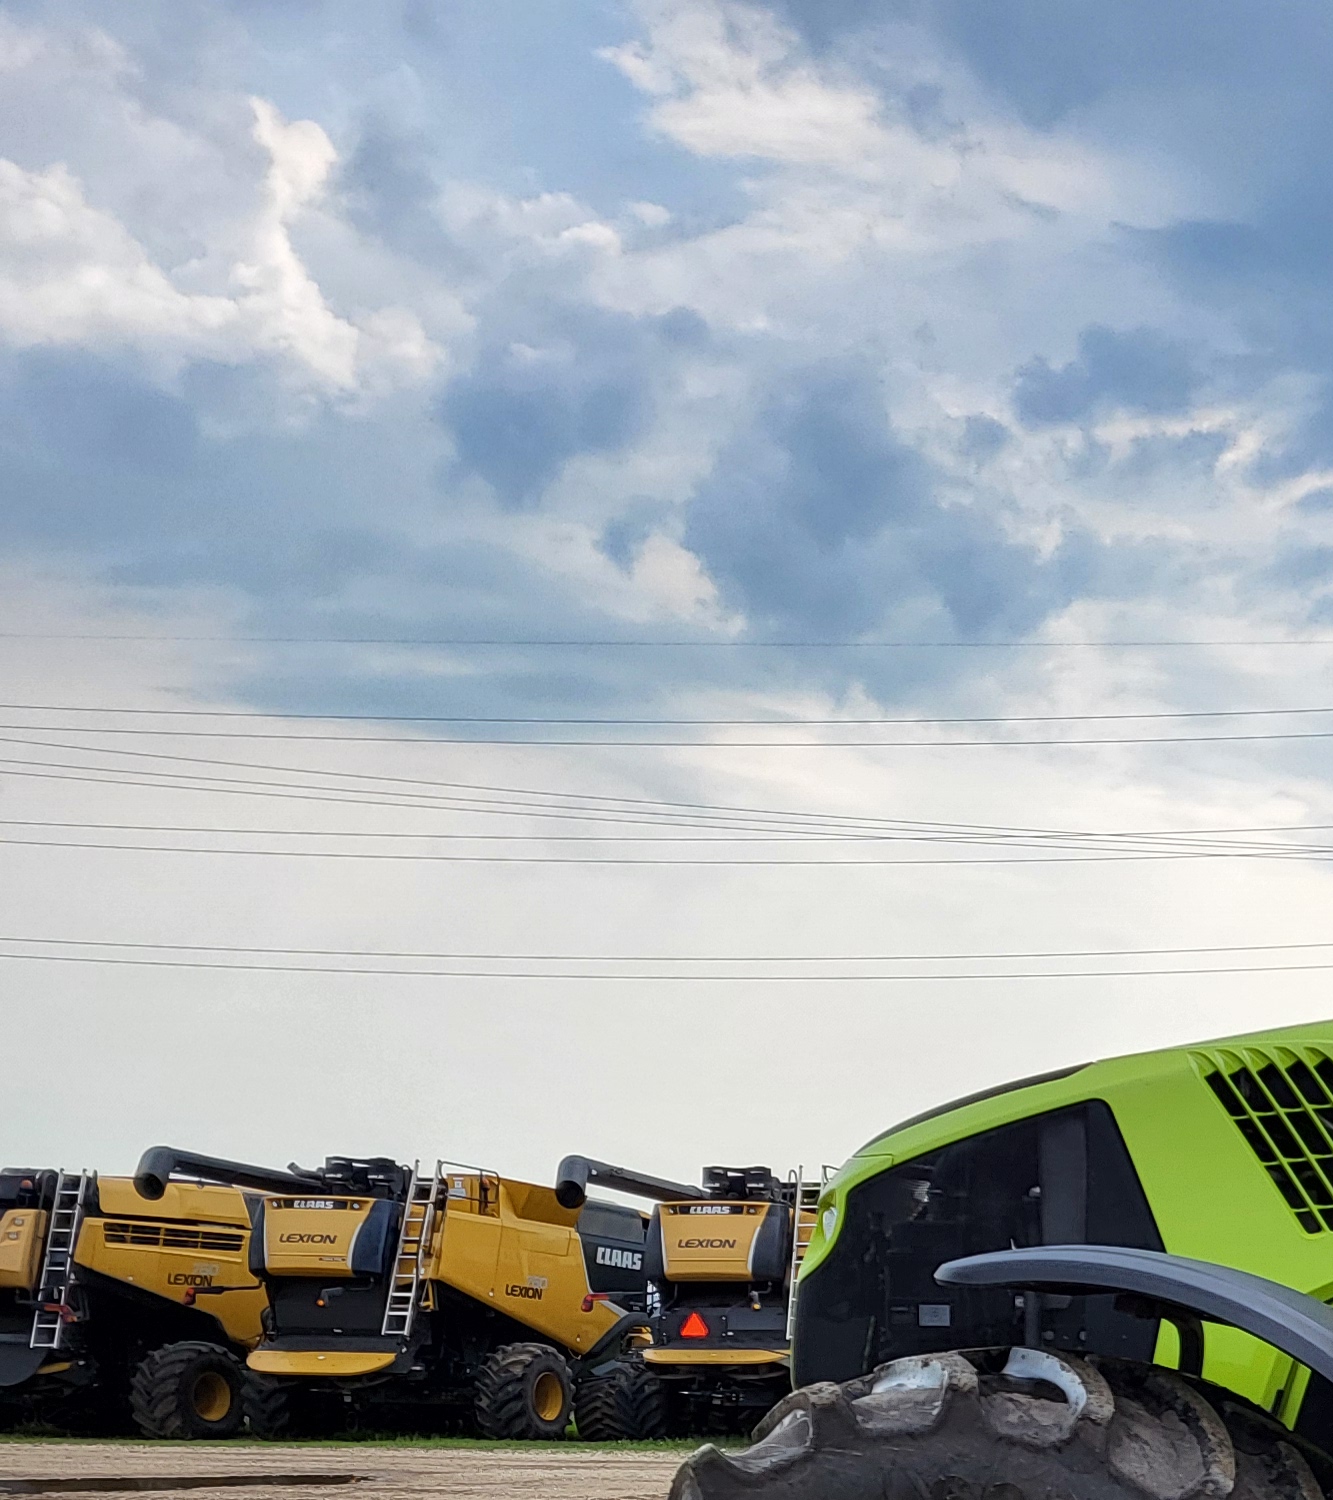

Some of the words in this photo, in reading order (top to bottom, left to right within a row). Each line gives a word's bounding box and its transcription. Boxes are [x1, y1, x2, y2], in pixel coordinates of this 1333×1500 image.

[293, 1200, 334, 1209] CLAAS
[689, 1206, 731, 1215] CLAAS
[279, 1233, 338, 1244] LEXION
[677, 1238, 737, 1249] LEXION
[595, 1246, 643, 1271] CLAAS
[167, 1272, 213, 1288] LEXION
[505, 1283, 543, 1300] LEXION
